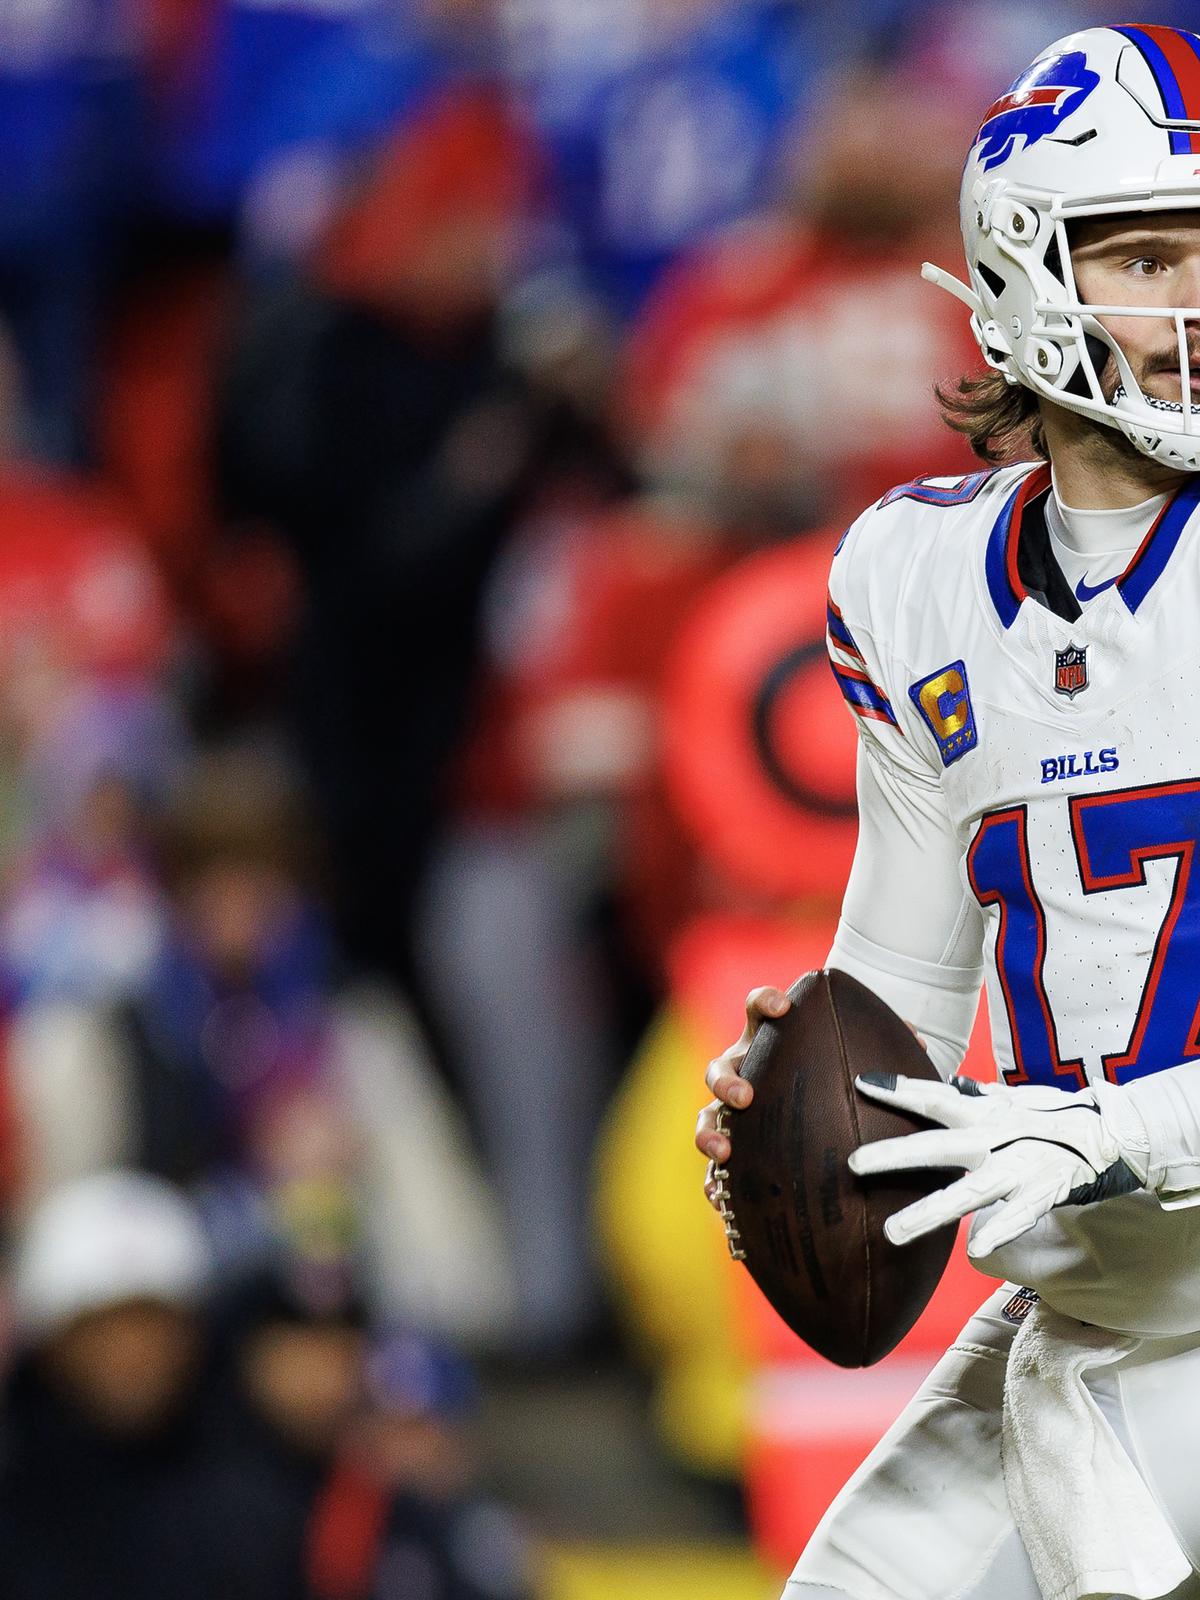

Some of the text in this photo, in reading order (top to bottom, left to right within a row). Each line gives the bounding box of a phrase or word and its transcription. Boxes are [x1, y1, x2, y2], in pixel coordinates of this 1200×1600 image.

[1057, 664, 1086, 689] NFL
[919, 668, 969, 740] C
[1040, 747, 1120, 784] BILLS
